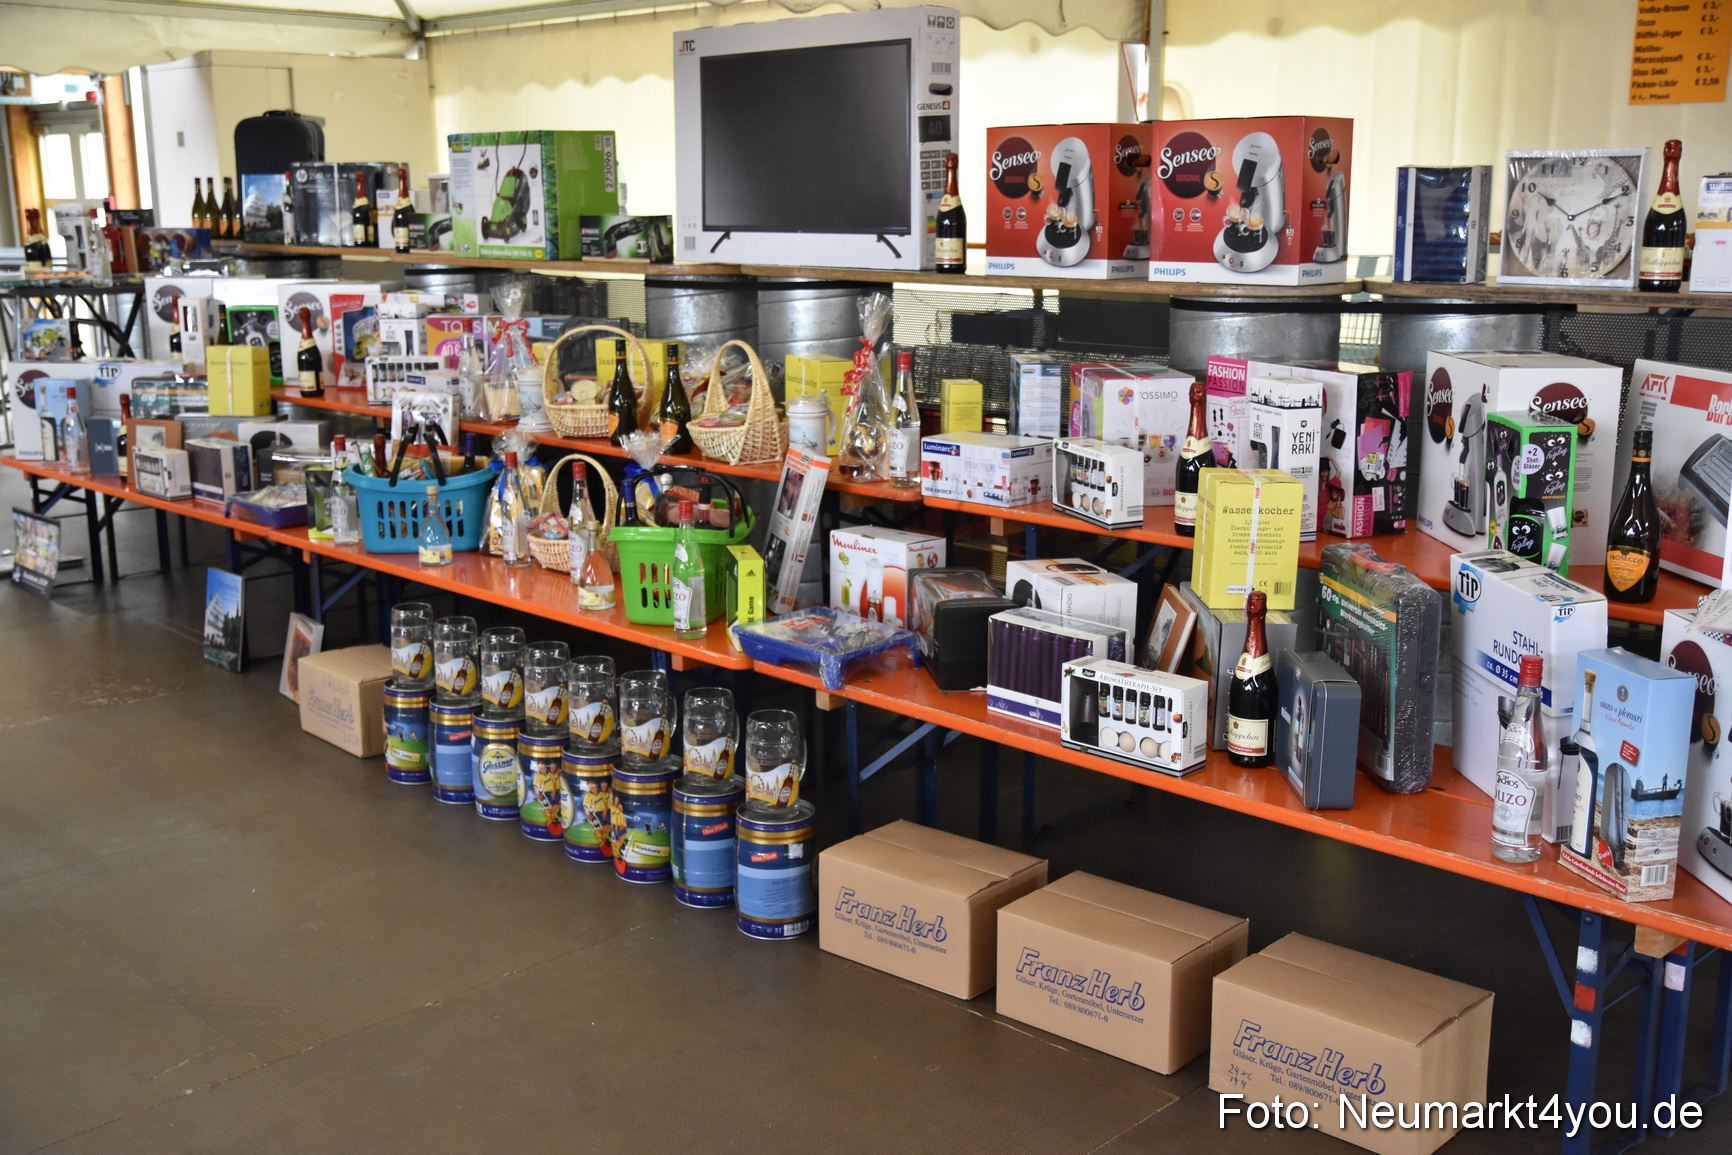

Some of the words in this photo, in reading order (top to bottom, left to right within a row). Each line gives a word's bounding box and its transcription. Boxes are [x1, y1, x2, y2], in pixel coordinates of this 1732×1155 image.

[679, 40, 696, 52] JTC
[917, 102, 942, 110] GENESIS
[928, 121, 942, 136] 40
[1308, 138, 1333, 160] Senseo
[605, 152, 613, 190] 273096
[990, 150, 1041, 180] Senseo
[1157, 146, 1220, 180] Senseo
[1521, 182, 1536, 193] 10
[1512, 209, 1519, 220] 9
[1626, 216, 1634, 227] 3
[988, 262, 1015, 270] PHILIPS
[1154, 267, 1186, 276] PHILIPS
[1302, 269, 1322, 278] PHILIPS
[1561, 266, 1569, 278] 6
[1590, 262, 1598, 272] 5
[1208, 364, 1245, 381] FASHION
[1208, 376, 1244, 392] PASSION
[1641, 373, 1670, 394] AFK
[1427, 382, 1454, 416] Senseo
[1529, 396, 1590, 416] Senseo
[924, 442, 952, 453] Luminarc
[1222, 506, 1294, 515] Wassekocher
[1356, 498, 1364, 536] FASHION
[831, 534, 878, 555] Moulinex
[1458, 571, 1478, 598] TiP
[1513, 630, 1543, 656] STAHL-
[1502, 669, 1509, 679] 35
[1510, 675, 1518, 685] cm
[483, 759, 514, 774] Glossner
[835, 886, 897, 928] Franz
[896, 905, 948, 942] Herb
[1016, 946, 1088, 992] Franz
[1086, 969, 1146, 1011] Herb
[1016, 974, 1038, 988] Gläser,
[1039, 982, 1061, 998] Krüge,
[1062, 989, 1105, 1011] Gartenmöbel,
[1107, 1004, 1144, 1024] Untersetzer
[1049, 996, 1062, 1007] Tel.:
[1064, 1000, 1108, 1023] 089/800671-0
[1233, 1018, 1317, 1073] Franz
[1316, 1048, 1386, 1096] Herb
[1233, 1048, 1258, 1065] Gläser,
[1259, 1058, 1284, 1076] Krüge,
[1286, 1067, 1337, 1094] Gartenmöbel,
[1270, 1074, 1287, 1086] Tel.:
[1289, 1081, 1340, 1105] 089/800671-0
